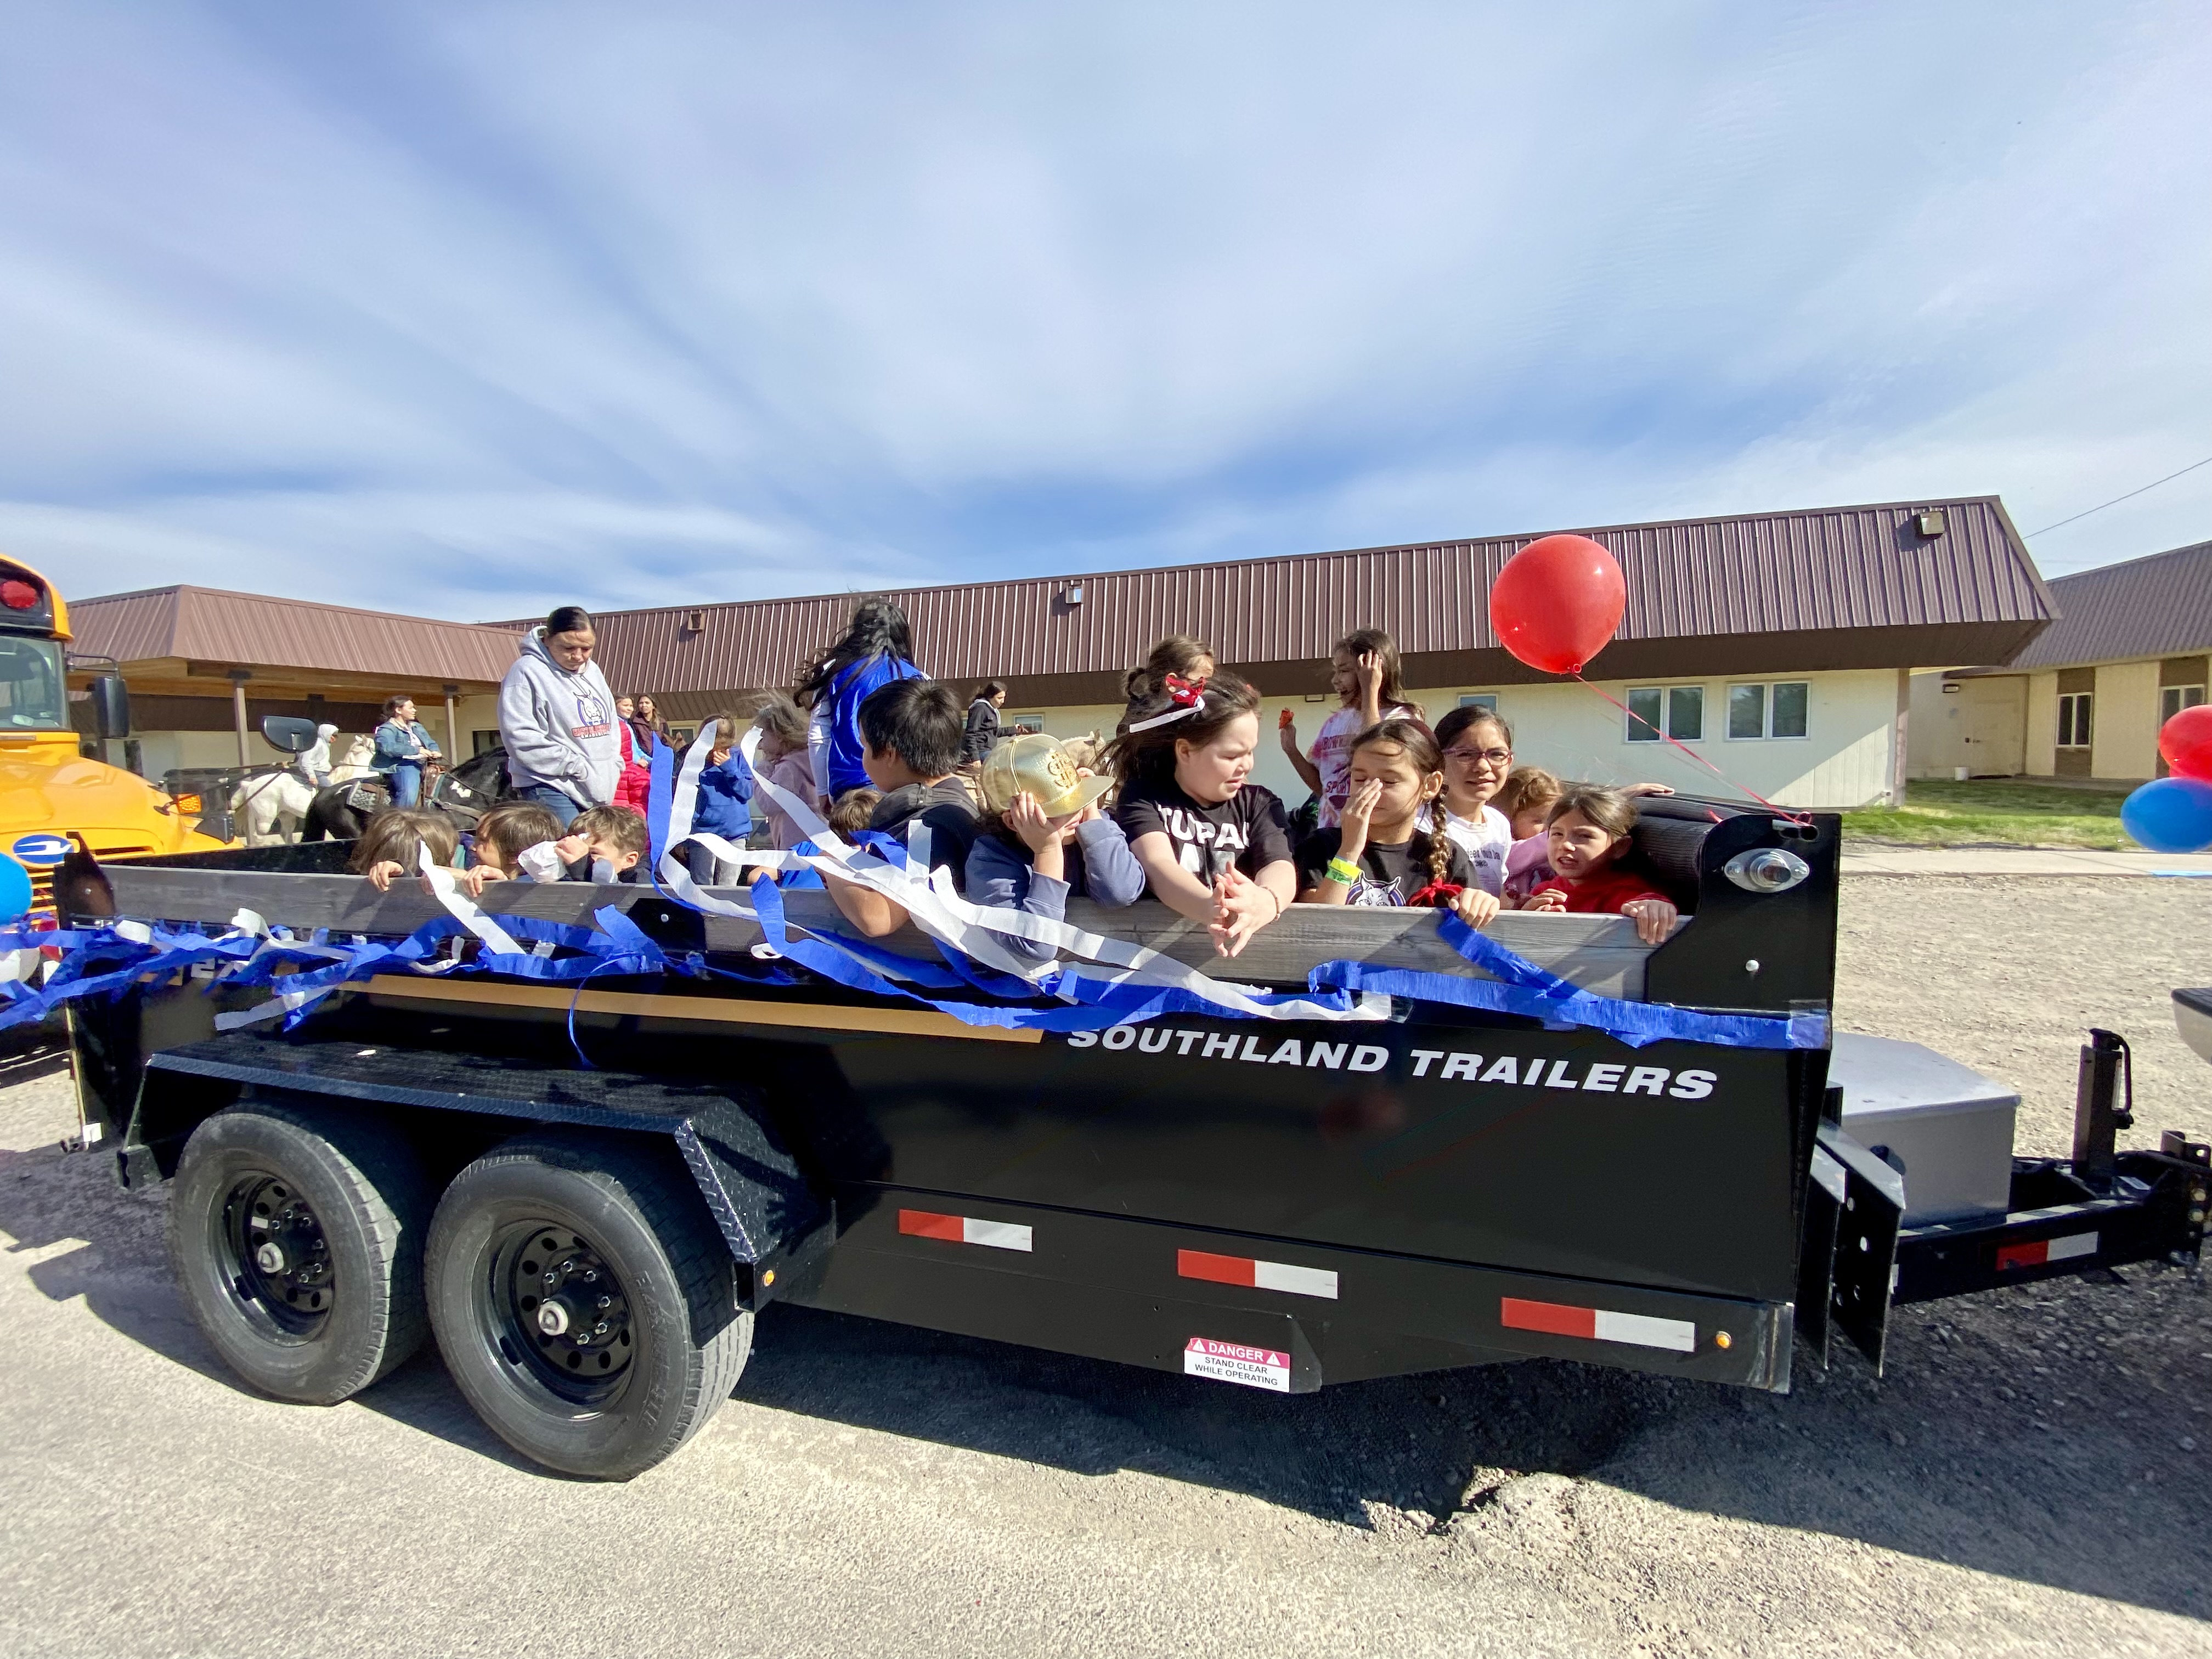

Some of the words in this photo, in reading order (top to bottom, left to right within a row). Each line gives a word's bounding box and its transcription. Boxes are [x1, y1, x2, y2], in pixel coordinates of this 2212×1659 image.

[1068, 1025, 1390, 1072] SOUTHLAND
[1409, 1049, 1718, 1099] TRAILERS
[1209, 1342, 1264, 1362] DANGER
[1195, 1364, 1223, 1375] WHILE
[1226, 1370, 1278, 1386] OPERATING
[1205, 1357, 1234, 1368] STAND
[1237, 1363, 1267, 1374] CLEAR
